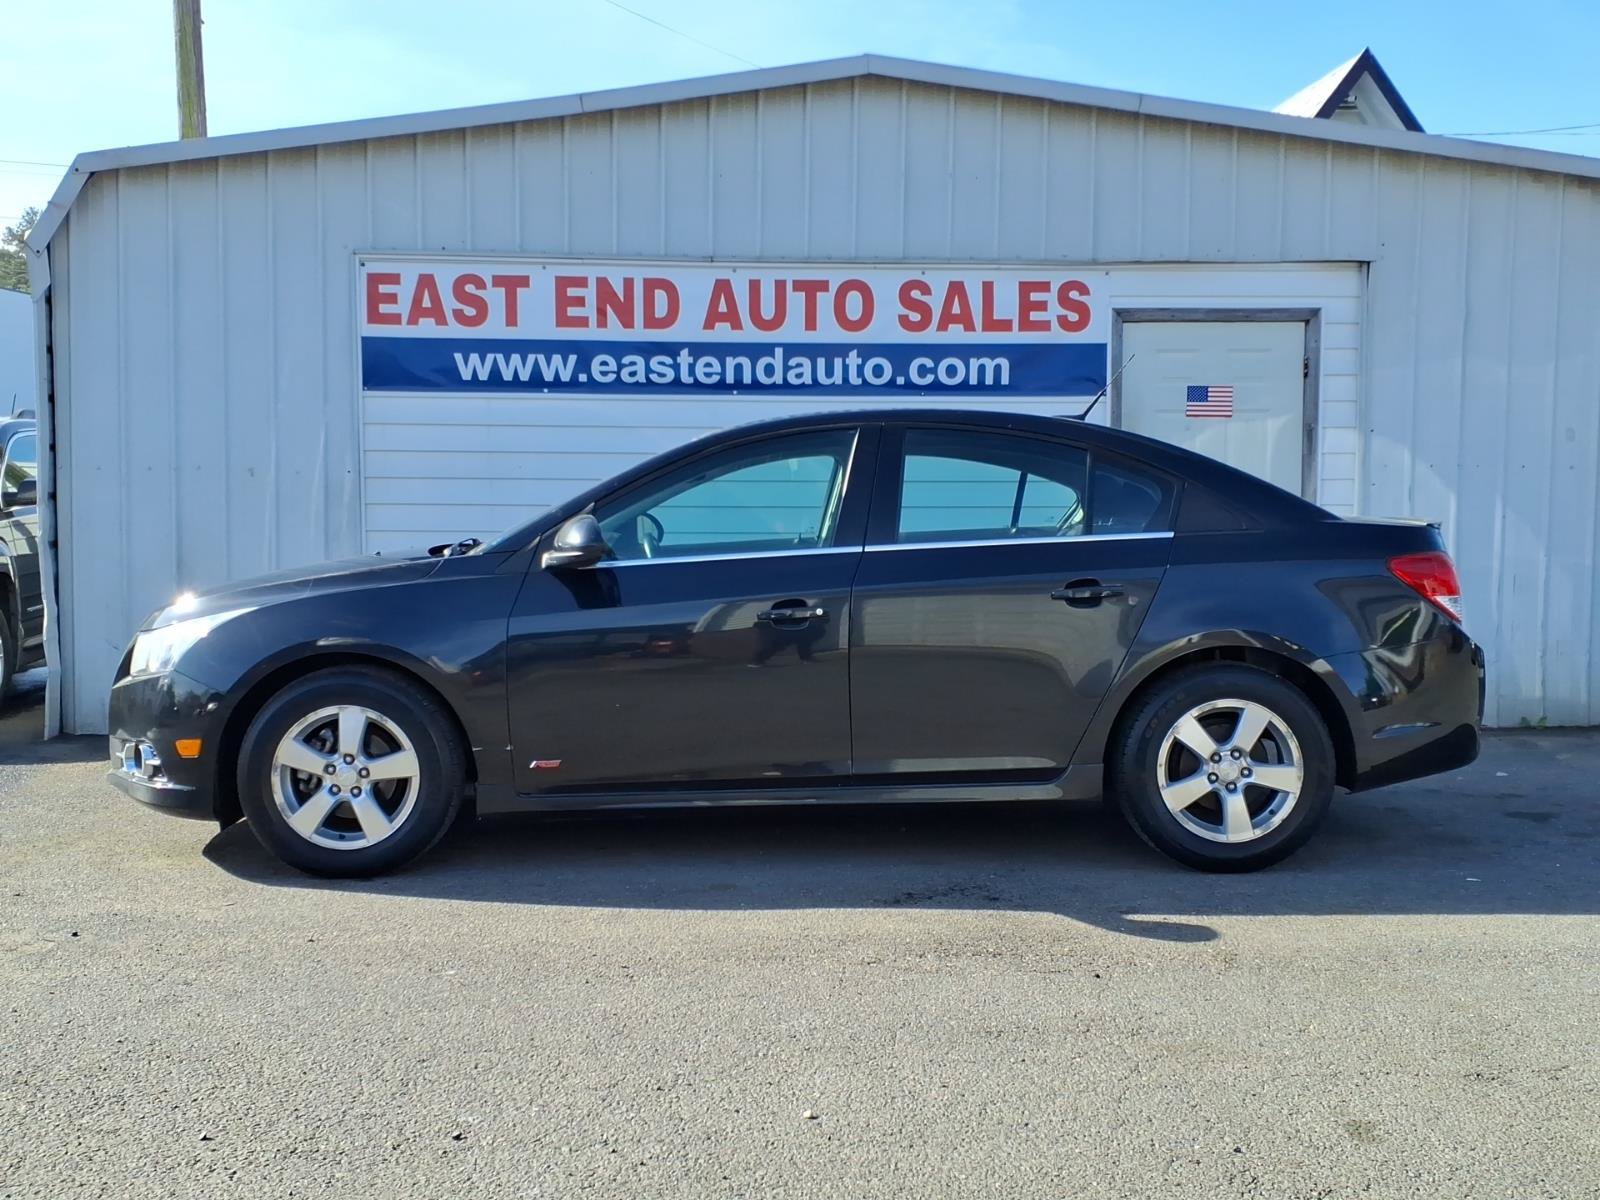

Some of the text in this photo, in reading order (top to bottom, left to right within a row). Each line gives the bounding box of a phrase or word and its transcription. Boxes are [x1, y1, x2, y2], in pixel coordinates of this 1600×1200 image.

[366, 273, 1091, 333] EAST END AUTO SALES
[453, 347, 1010, 385] www.eastendauto.com
